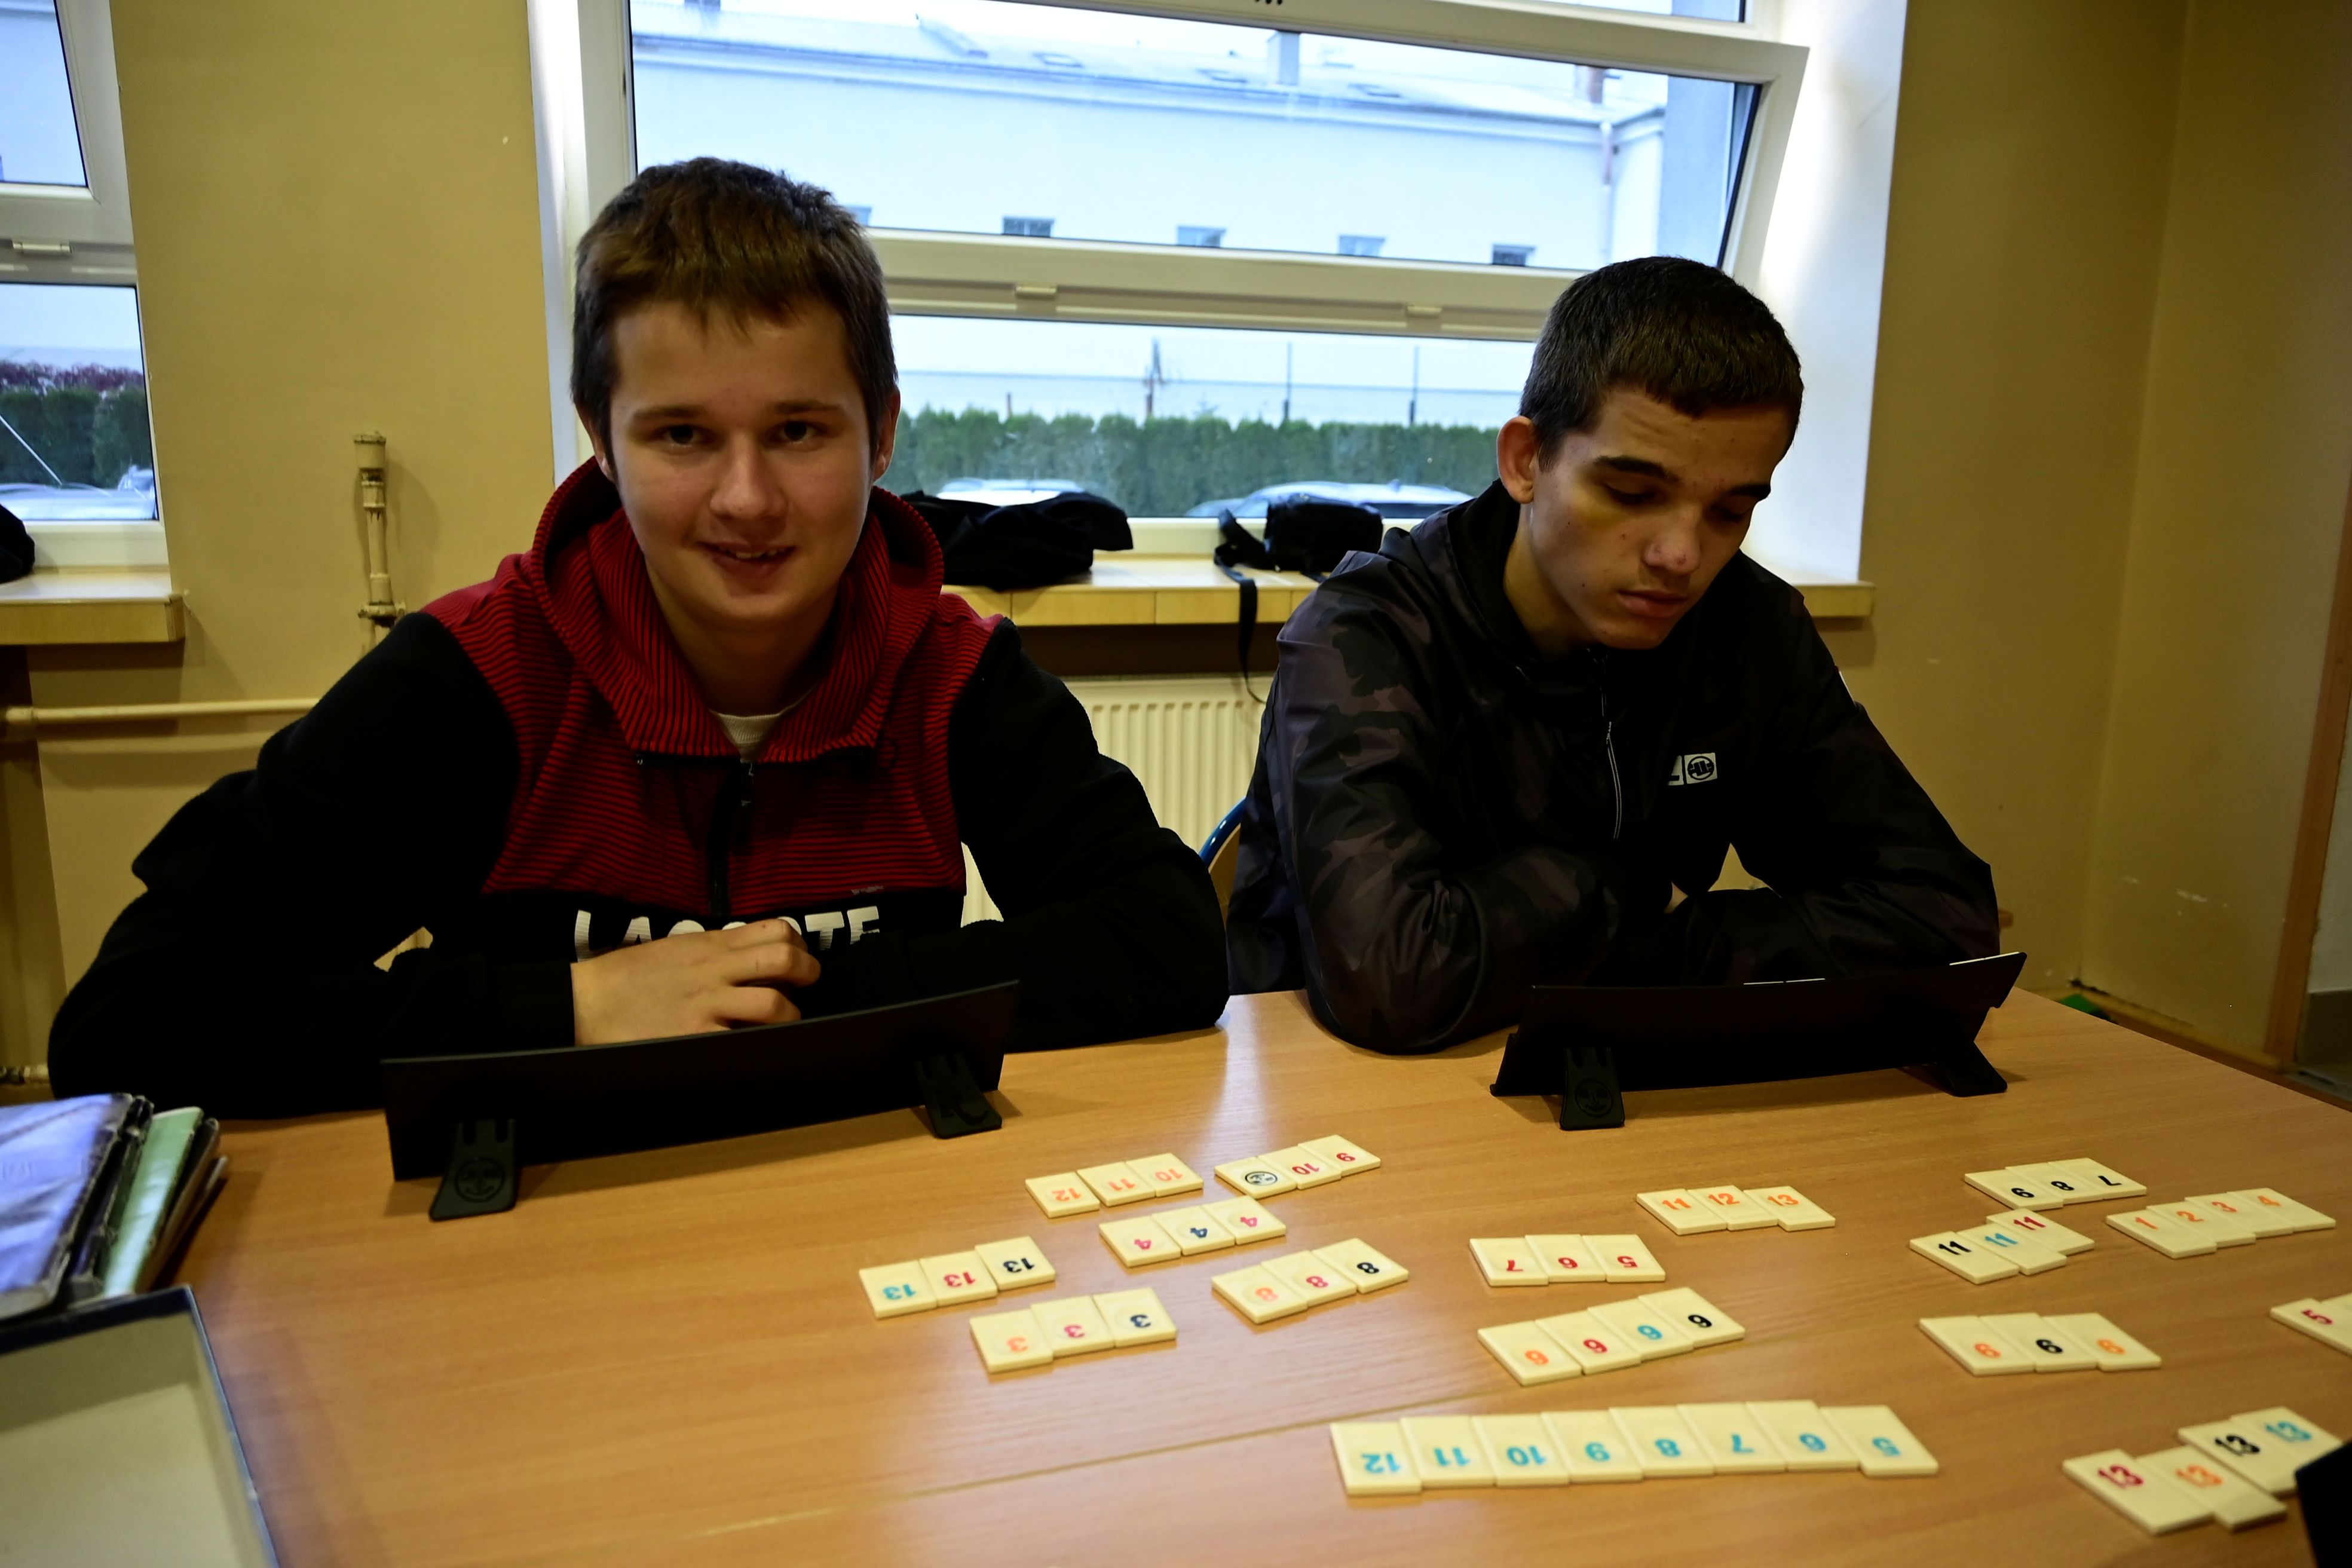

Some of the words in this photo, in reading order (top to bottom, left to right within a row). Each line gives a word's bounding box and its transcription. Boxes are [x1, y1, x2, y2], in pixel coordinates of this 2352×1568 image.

[574, 906, 880, 961] LATE
[1154, 1169, 1183, 1182] 10
[1292, 1163, 1319, 1175] 10
[1109, 1178, 1135, 1192] 11
[2051, 1181, 2074, 1190] 8
[2098, 1176, 2121, 1186] 7
[1052, 1188, 1081, 1202] 12
[1662, 1198, 1691, 1210] 11
[1708, 1193, 1740, 1205] 12
[1768, 1195, 1799, 1206] 13
[1240, 1217, 1257, 1227] 4
[2135, 1217, 2158, 1230] 1
[2176, 1211, 2204, 1223] 2
[2212, 1201, 2237, 1213] 3
[1190, 1228, 1208, 1238] 4
[1938, 1241, 1971, 1255] 11
[1984, 1233, 2018, 1248] 11
[2014, 1217, 2047, 1230] 11
[1134, 1239, 1152, 1250] 4
[1003, 1258, 1034, 1273] 13
[1357, 1263, 1379, 1274] 8
[1506, 1260, 1523, 1272] 7
[1618, 1256, 1638, 1268] 5
[944, 1272, 975, 1287] 13
[1306, 1276, 1329, 1288] 8
[883, 1284, 916, 1300] 13
[1255, 1287, 1278, 1301] 8
[1130, 1315, 1151, 1328] 3
[1064, 1325, 1085, 1339] 3
[1006, 1337, 1028, 1353] 3
[1731, 1434, 1754, 1453] 7
[2215, 1435, 2260, 1456] 13
[2265, 1421, 2312, 1443] 13
[1655, 1439, 1682, 1457] 8
[1872, 1437, 1901, 1457] 5
[1434, 1447, 1470, 1467] 11
[1506, 1446, 1546, 1466] 10
[1361, 1453, 1401, 1474] 12
[2098, 1465, 2145, 1489] 13
[2175, 1465, 2224, 1488] 13
